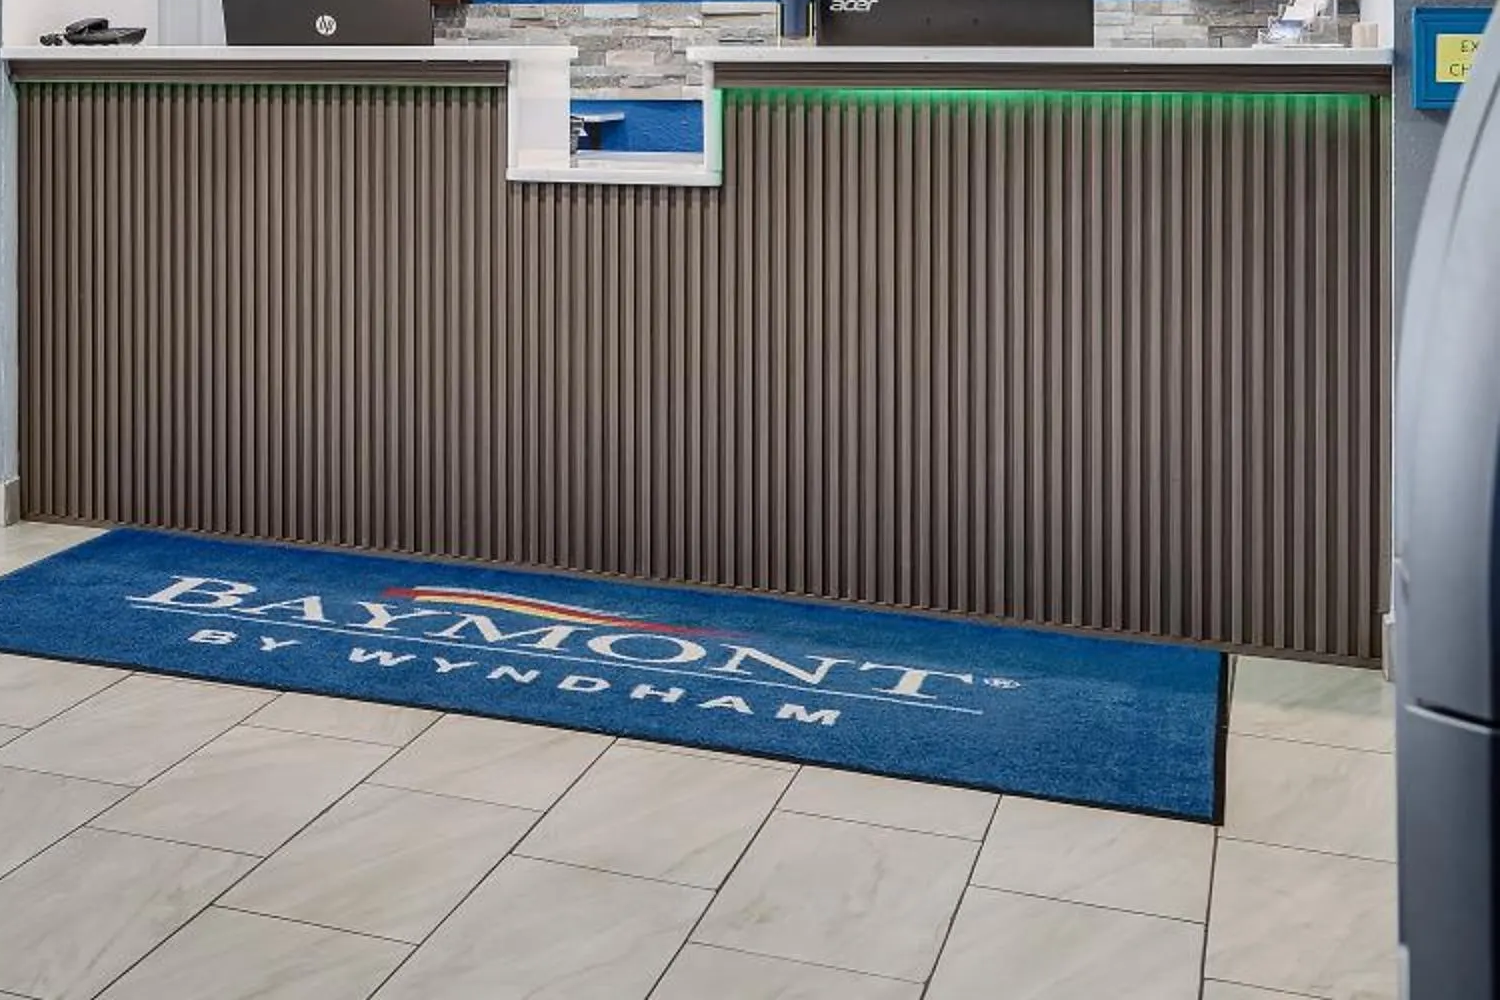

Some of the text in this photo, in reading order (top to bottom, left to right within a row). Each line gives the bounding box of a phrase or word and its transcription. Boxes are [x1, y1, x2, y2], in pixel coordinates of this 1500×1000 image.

[829, 0, 879, 12] acer
[316, 14, 337, 36] hp
[188, 629, 842, 727] BY WYNDHAM
